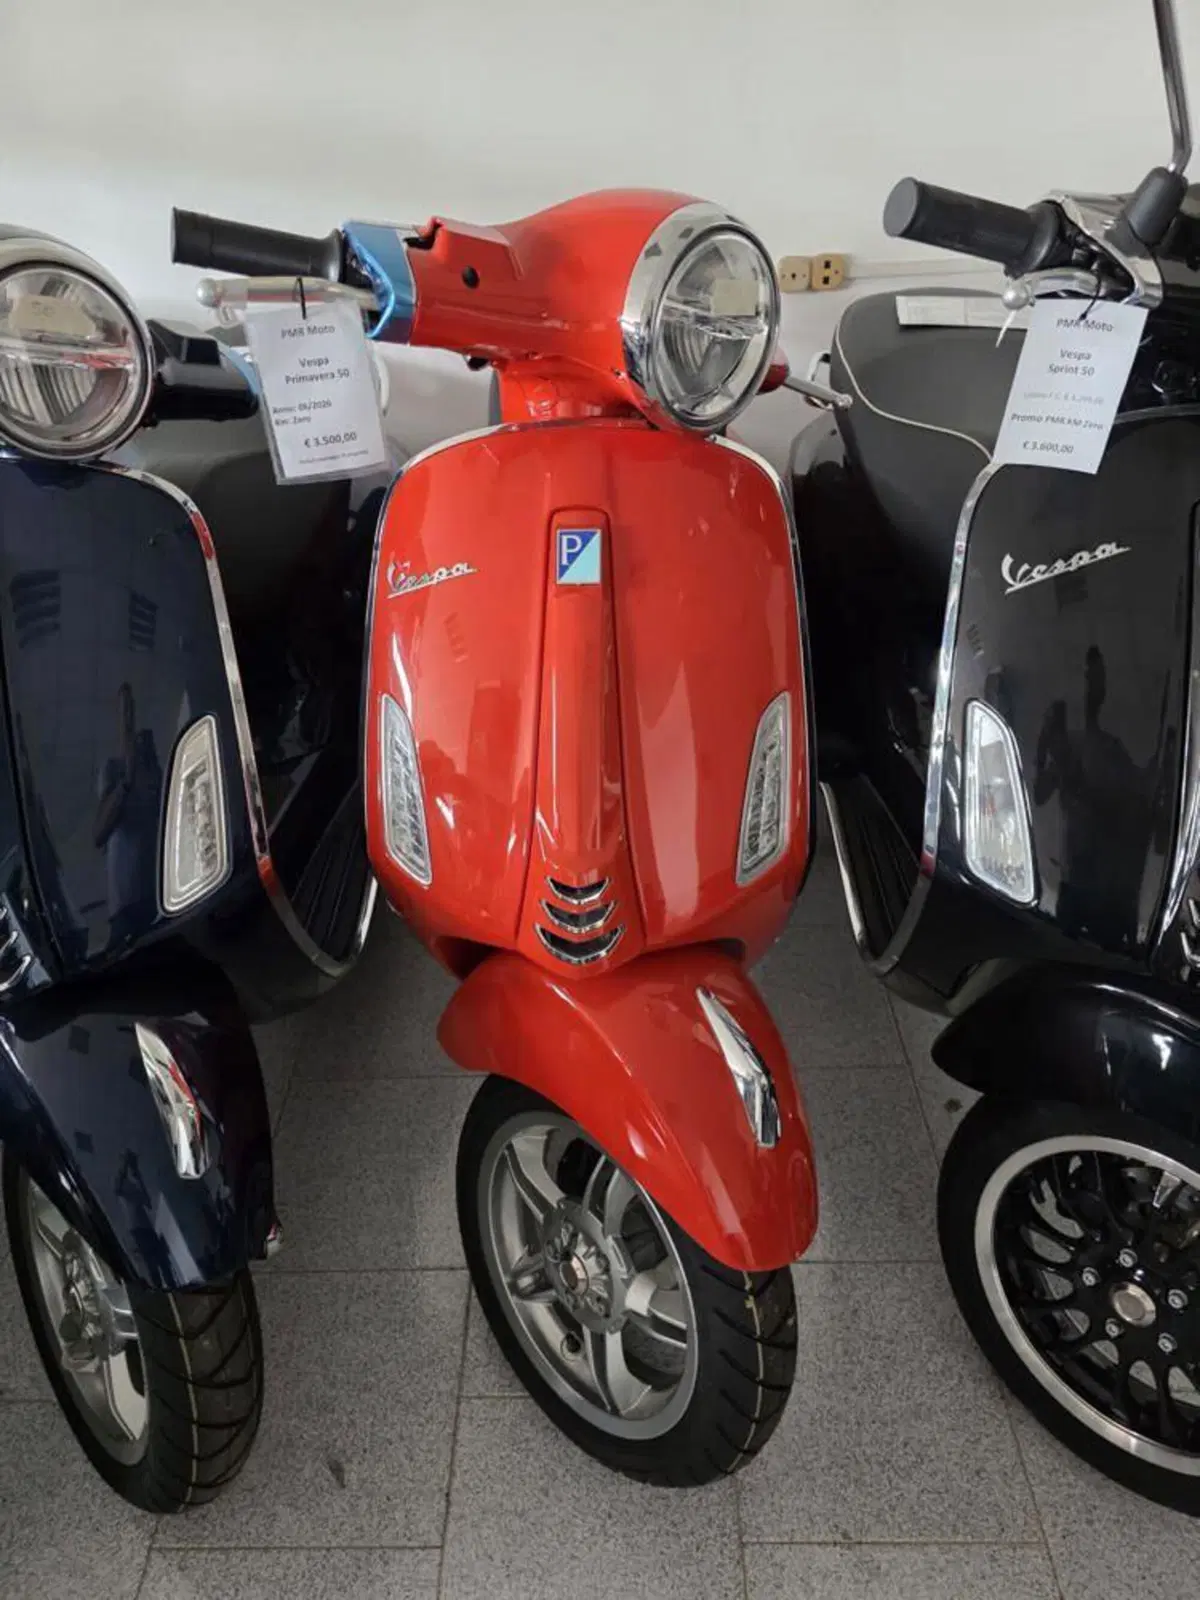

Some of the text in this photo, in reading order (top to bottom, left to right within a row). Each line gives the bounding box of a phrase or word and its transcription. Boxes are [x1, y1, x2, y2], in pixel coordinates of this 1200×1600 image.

[281, 324, 336, 339] PMR Moto
[1083, 320, 1114, 333] Moto
[1060, 349, 1092, 361] Vespa
[298, 357, 330, 368] Vespa
[1048, 363, 1095, 376] Sprint 50
[284, 368, 350, 385] Primavera 50
[1011, 413, 1043, 423] Promo
[562, 534, 583, 567] P
[1001, 541, 1132, 596] Vespa
[385, 557, 478, 600] Vespa
